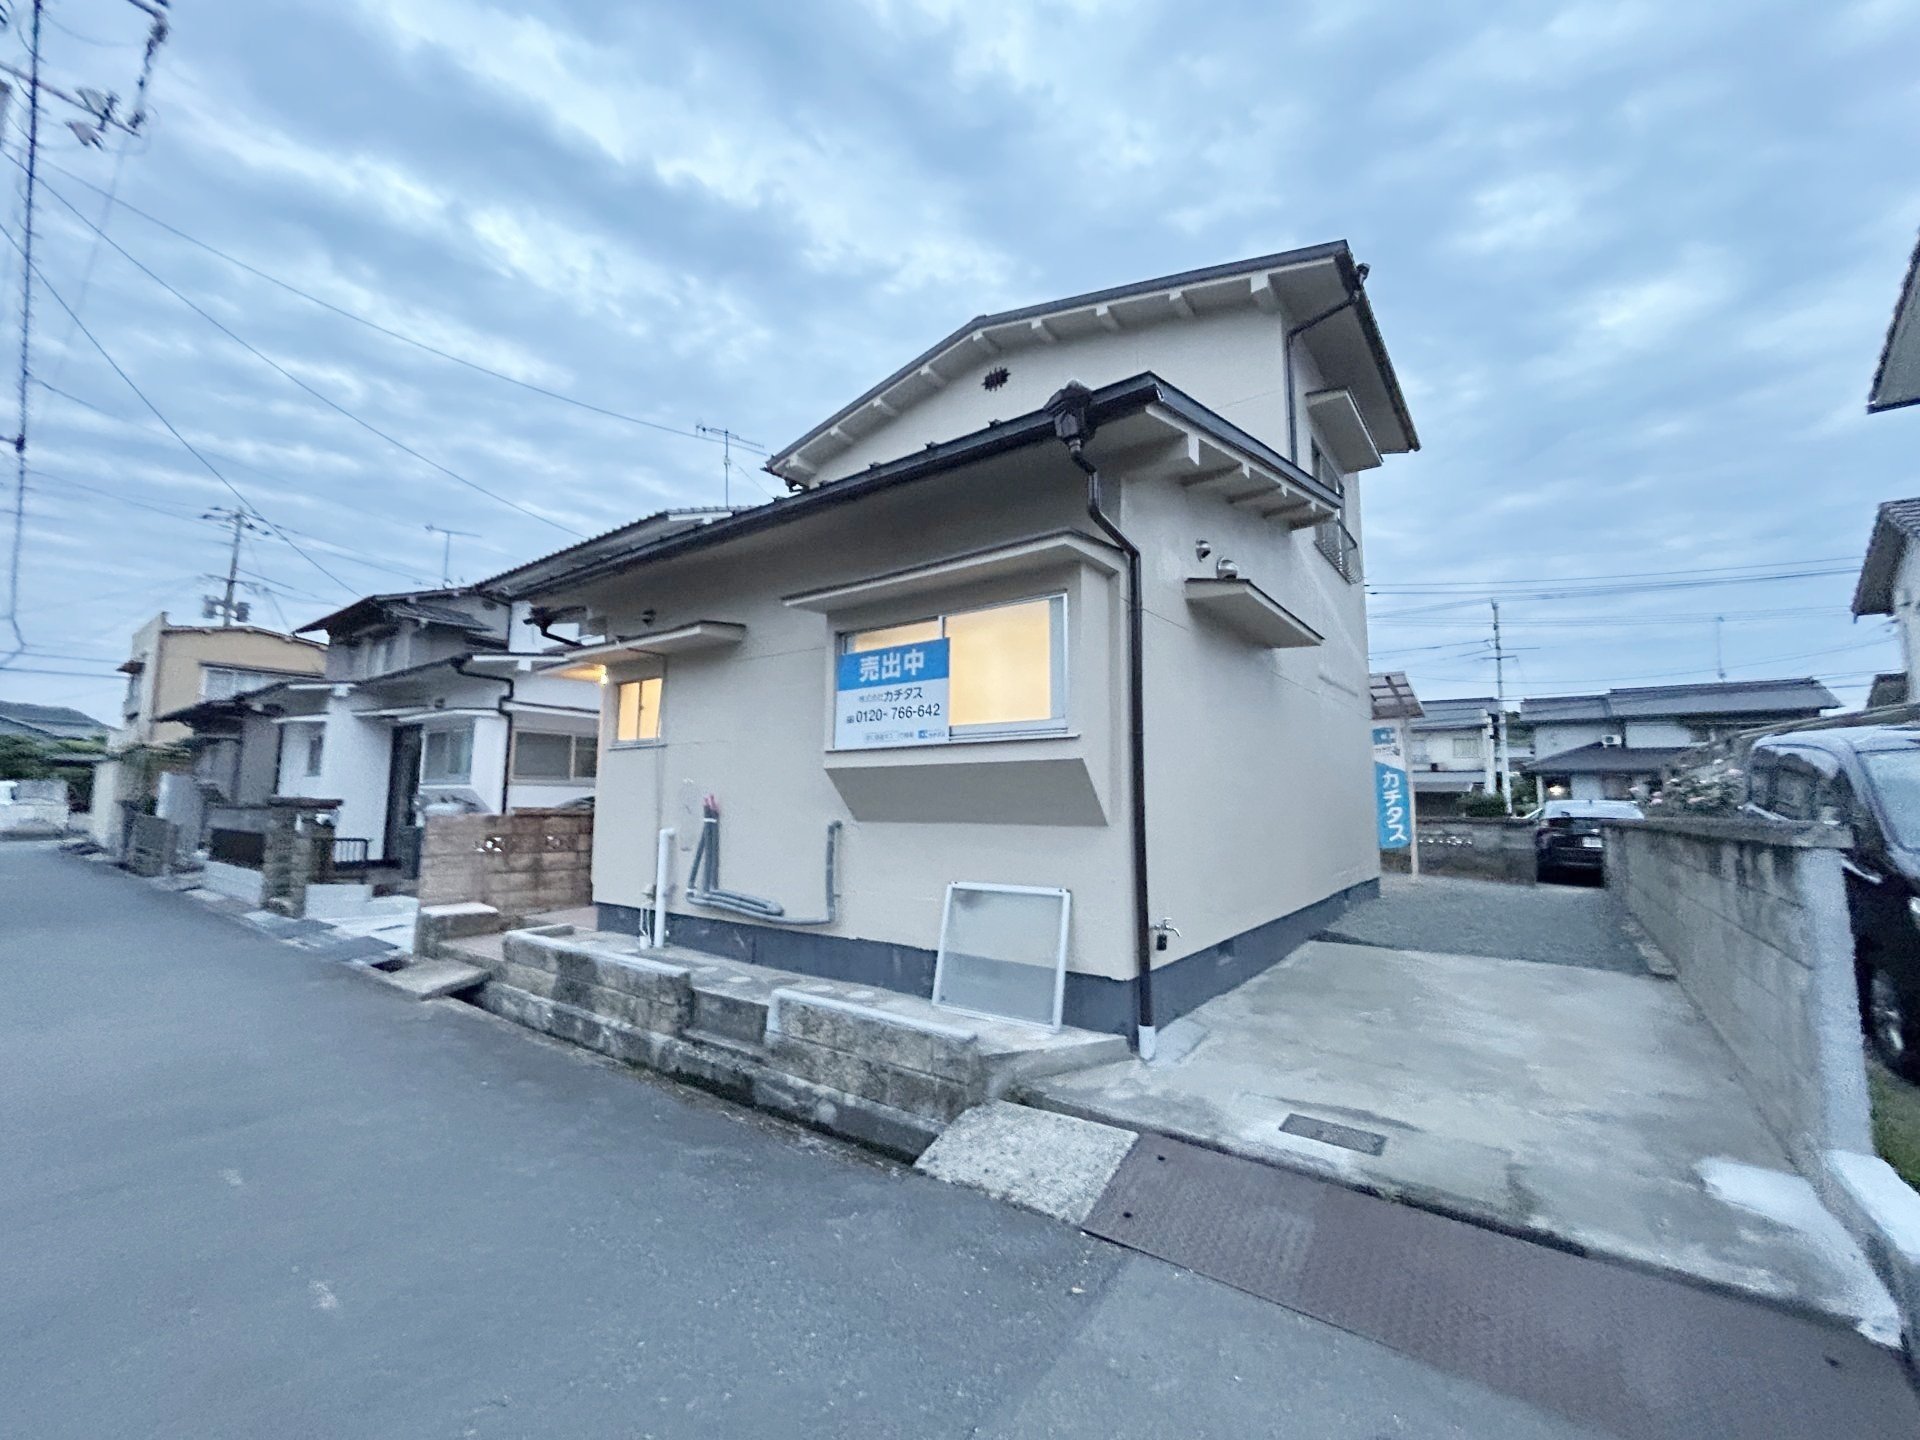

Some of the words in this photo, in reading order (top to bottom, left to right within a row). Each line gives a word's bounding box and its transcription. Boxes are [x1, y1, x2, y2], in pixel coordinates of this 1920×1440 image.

[859, 648, 925, 682] 売出中
[1382, 771, 1408, 842] カチタス
